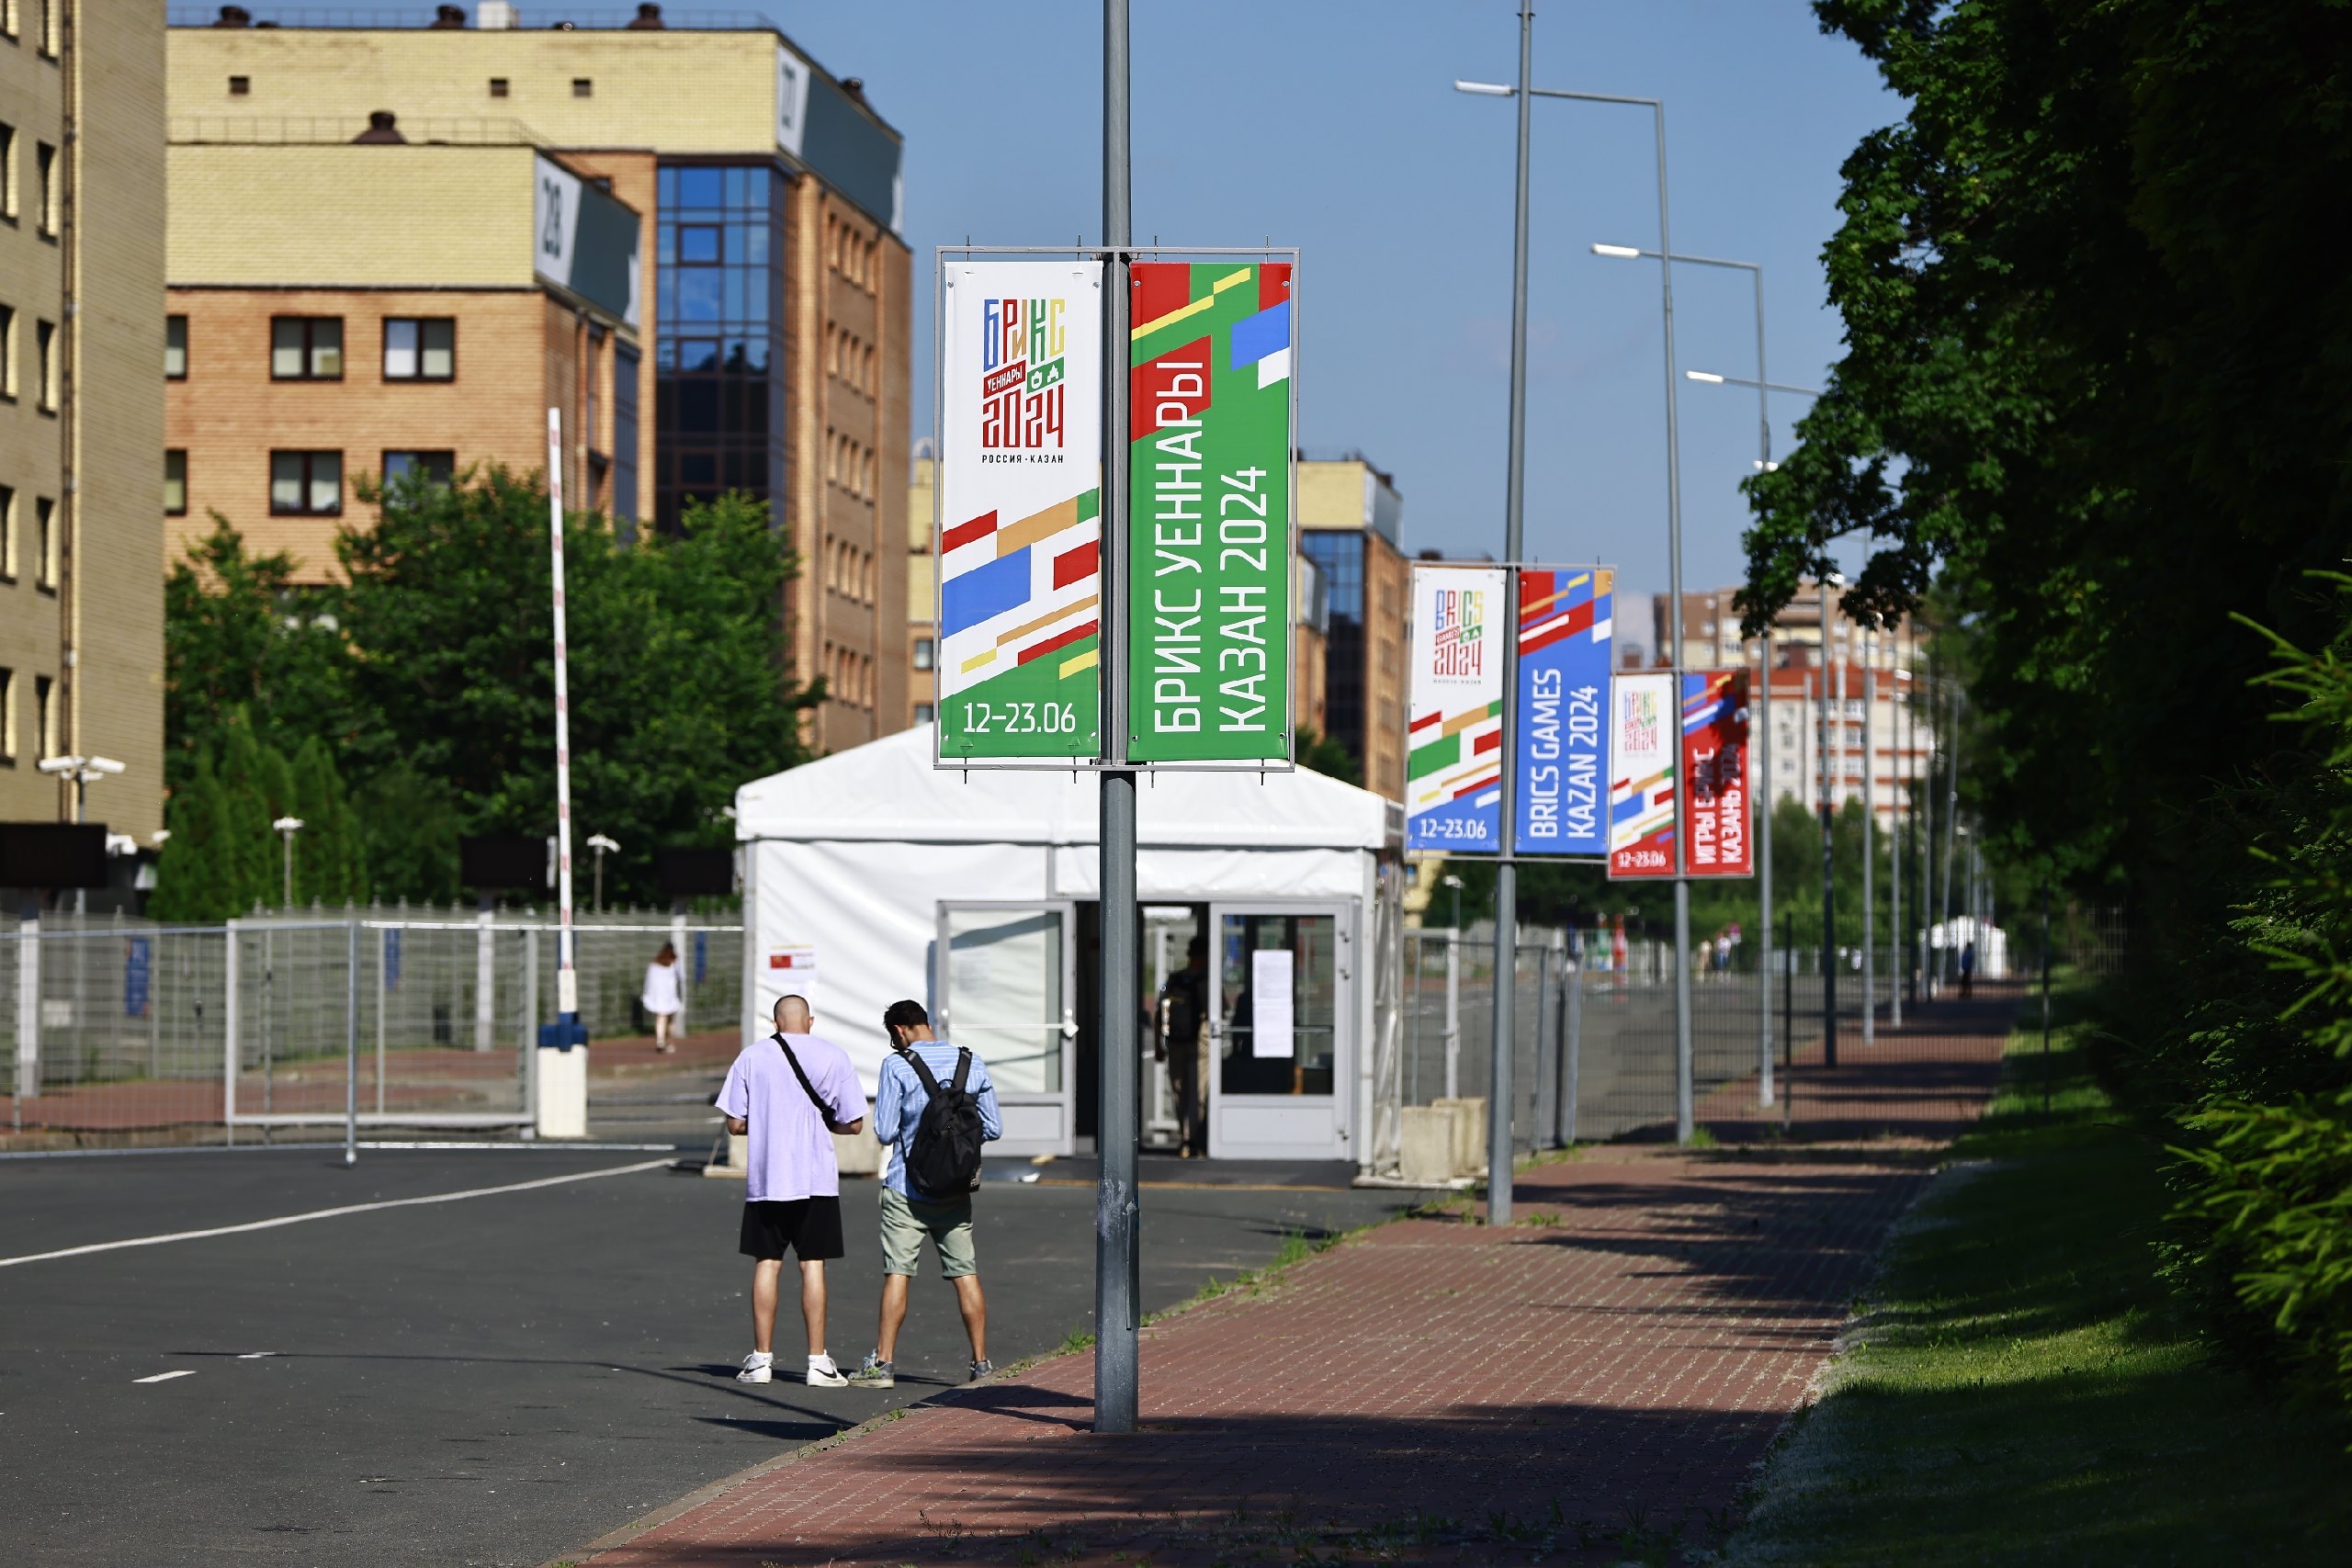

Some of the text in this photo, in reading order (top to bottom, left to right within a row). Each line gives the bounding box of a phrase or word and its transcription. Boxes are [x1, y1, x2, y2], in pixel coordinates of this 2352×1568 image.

[983, 299, 1066, 373] БРИКС
[987, 365, 1023, 393] УЕННАРЫ
[982, 383, 1064, 448] 2024
[981, 454, 1064, 464] РОССИЯ КАЗАН
[1154, 362, 1204, 733] БРИКС УЕННАРЫ
[1218, 466, 1267, 732] КАЗАН 2024
[1435, 590, 1484, 631] BRICS
[1433, 639, 1482, 677] 2024
[963, 702, 1076, 733] 12-23.06
[1529, 668, 1562, 838] BRICS GAMES
[1566, 685, 1599, 839] KAZAN 2024
[1419, 818, 1487, 840] 12-23.06
[1693, 811, 1717, 864] ИГРЫ
[1720, 788, 1743, 864] КАЗАНЬ
